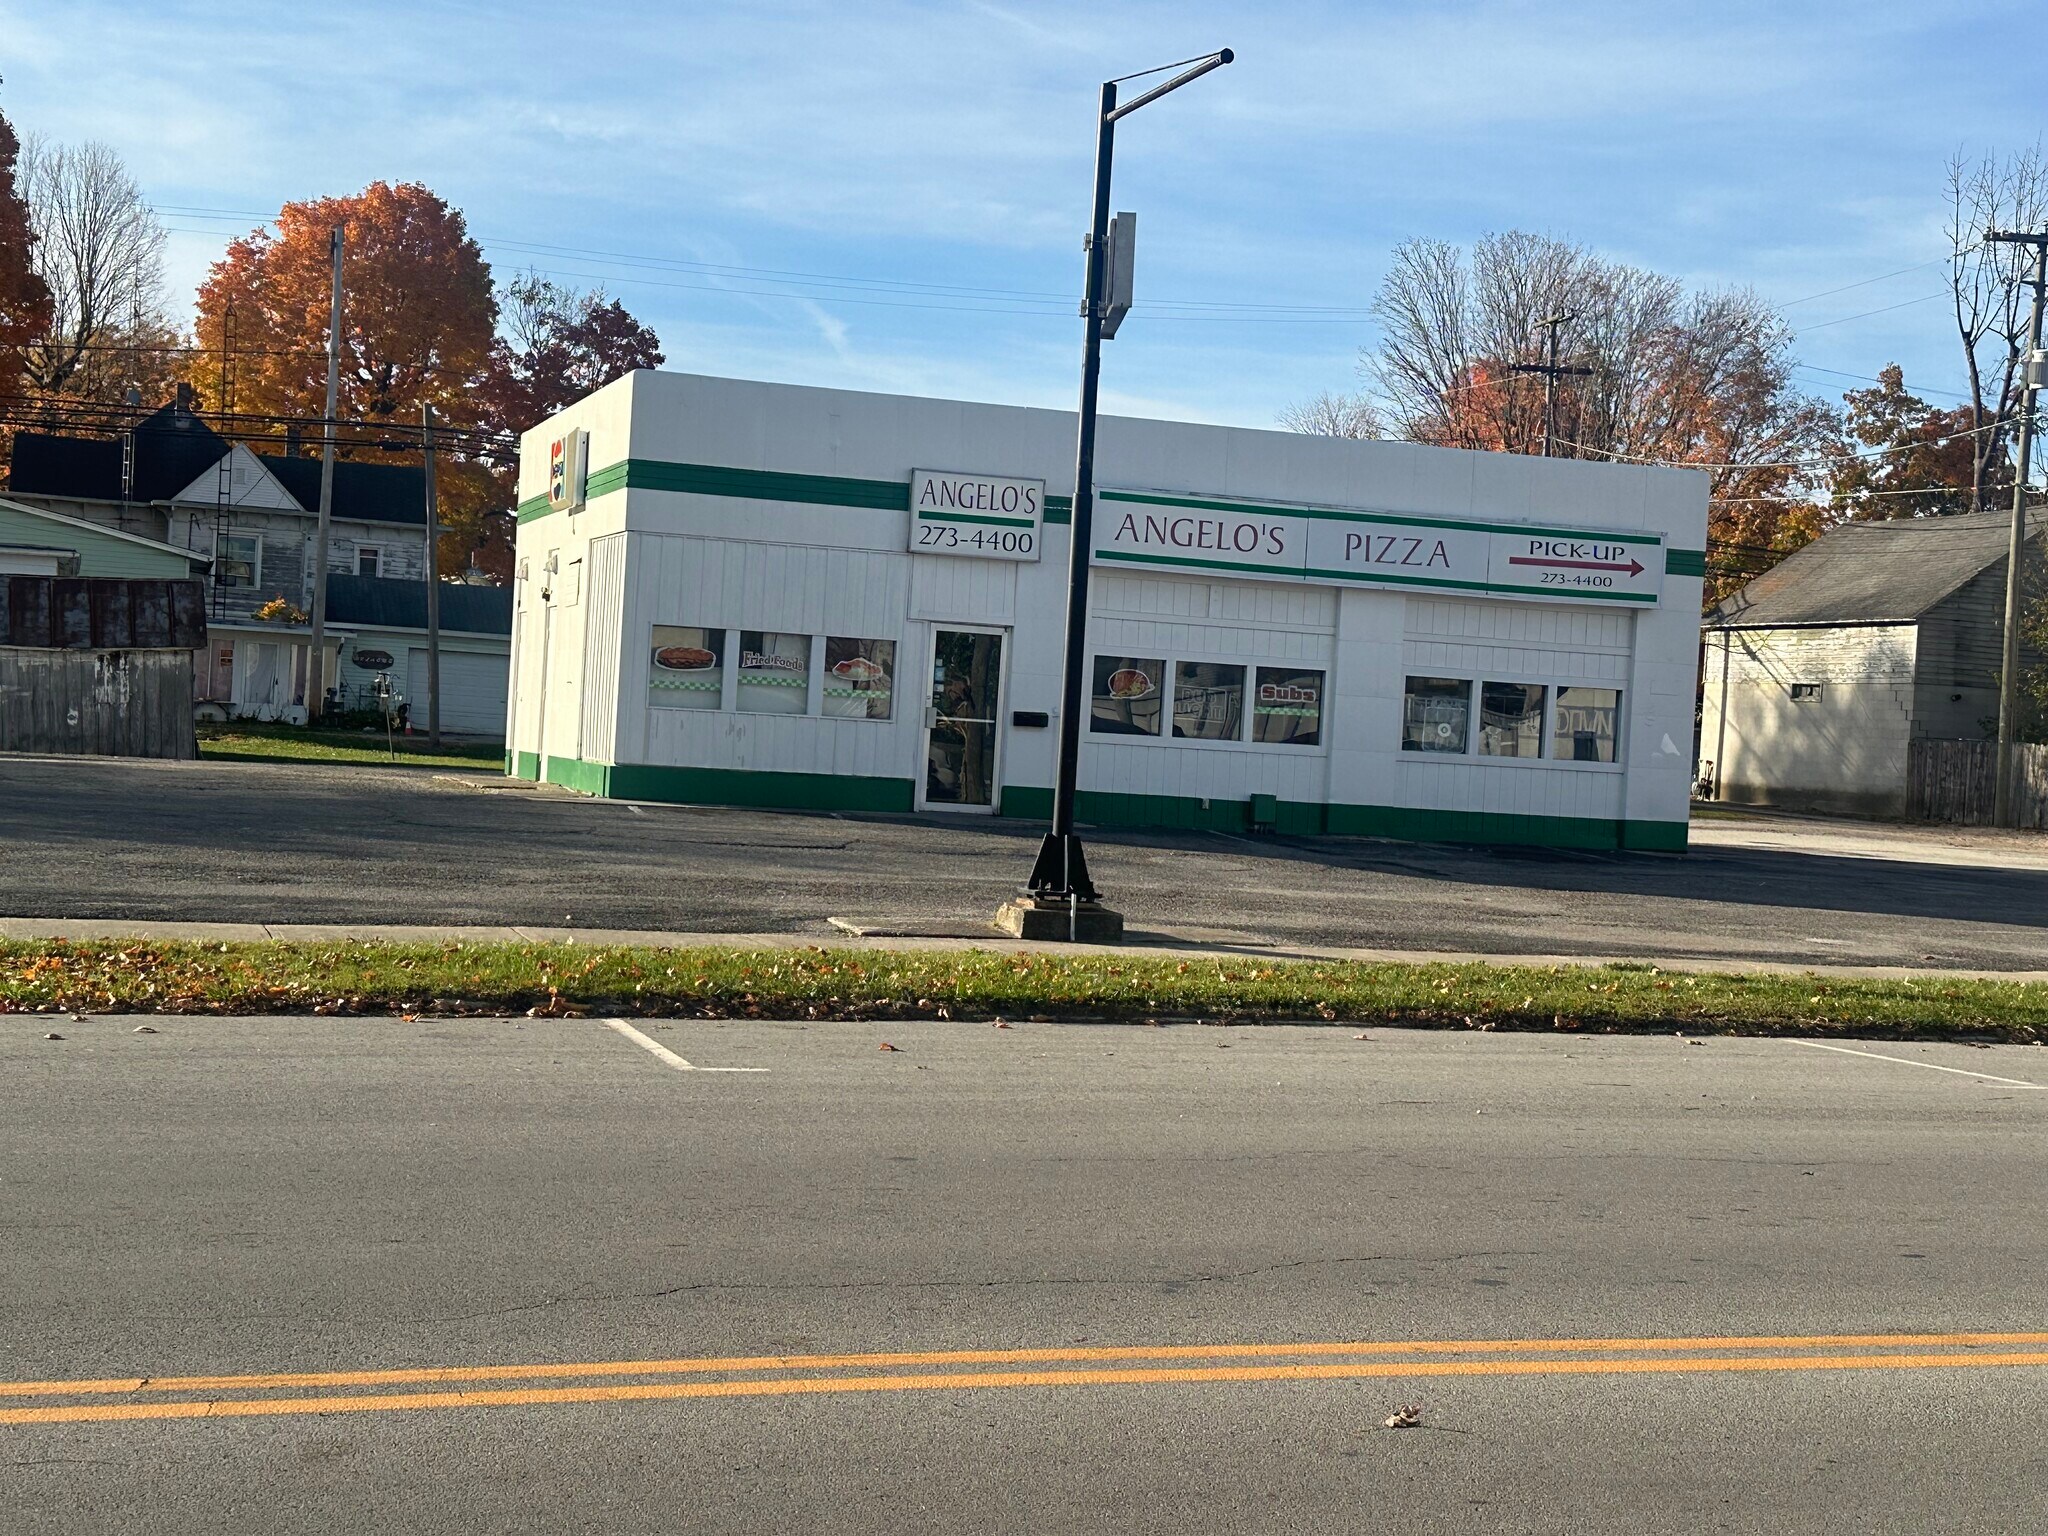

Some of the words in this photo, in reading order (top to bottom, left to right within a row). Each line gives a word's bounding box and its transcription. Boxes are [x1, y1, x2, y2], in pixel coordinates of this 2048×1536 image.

[919, 478, 1037, 515] ANGELO'S
[918, 525, 1034, 554] 273-4400
[1114, 512, 1286, 556] ANGELO'S
[1344, 532, 1451, 569] PIZZA
[1529, 540, 1626, 561] PICK-UP
[1540, 572, 1613, 588] 273-4400
[742, 650, 773, 668] Fried
[1261, 684, 1316, 703] Subs
